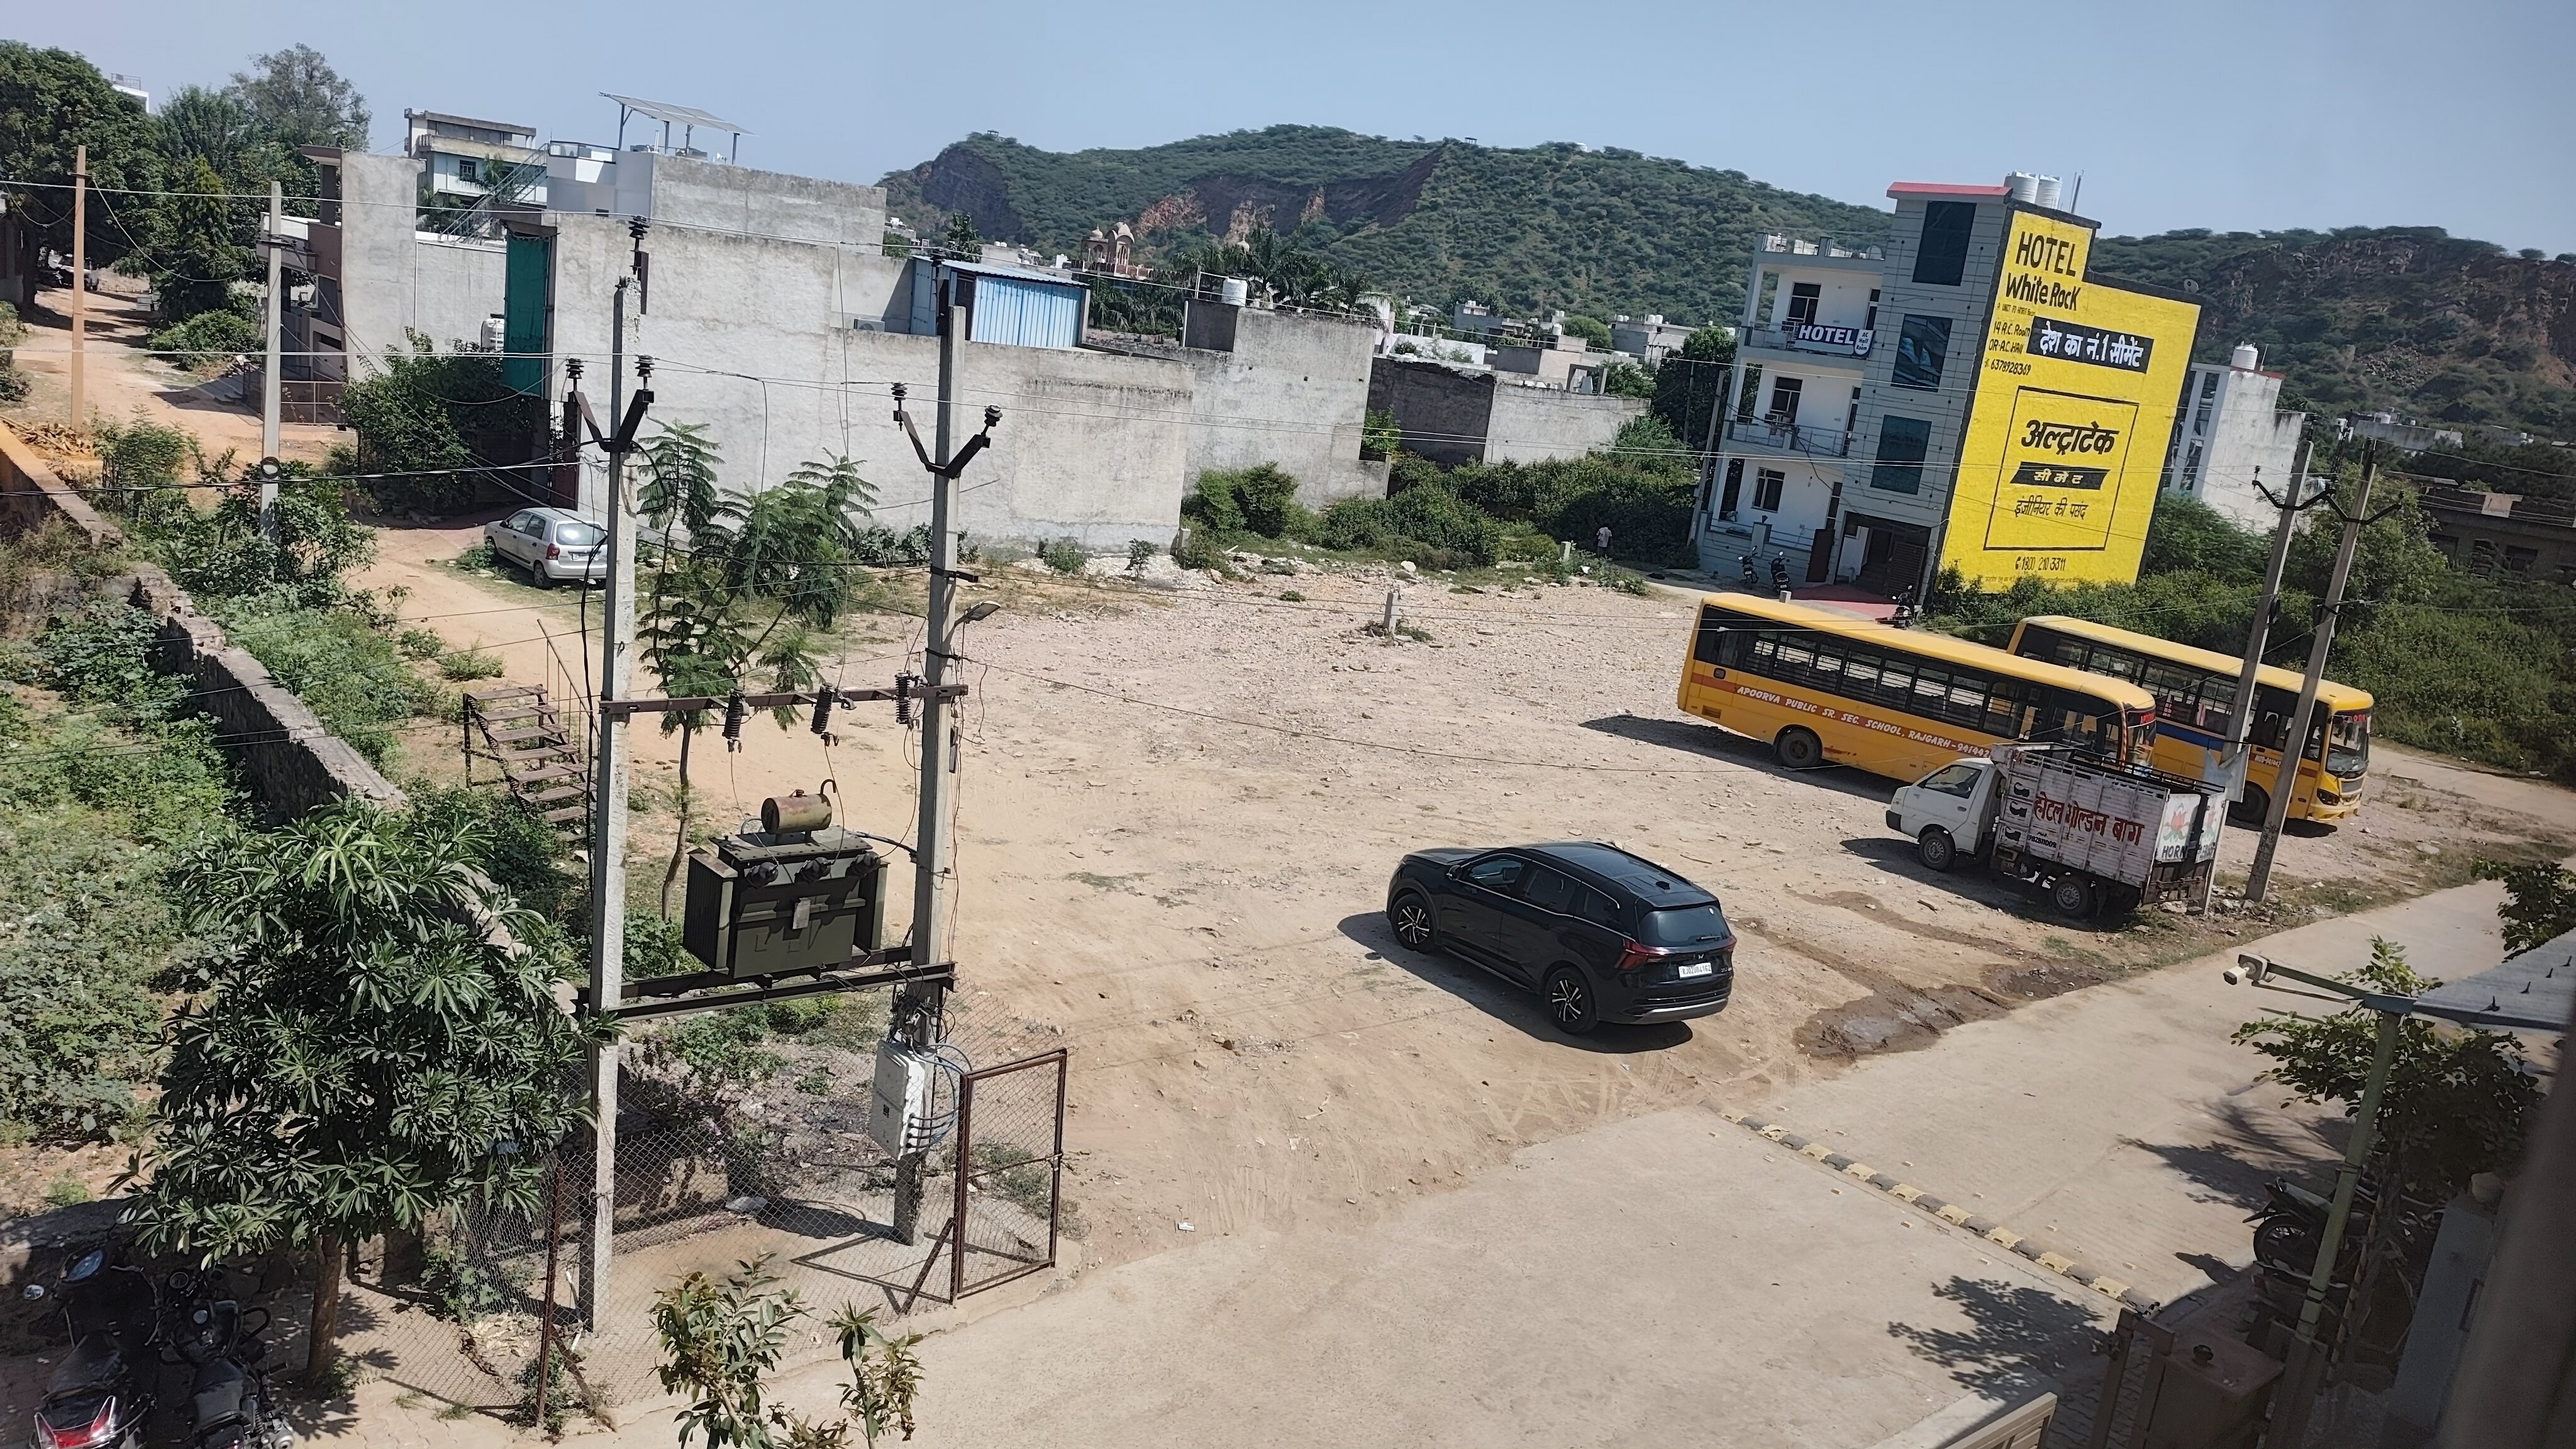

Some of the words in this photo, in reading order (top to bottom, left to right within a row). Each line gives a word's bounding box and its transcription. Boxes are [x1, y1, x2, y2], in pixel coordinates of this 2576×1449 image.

[2016, 231, 2076, 277] HOTEL
[2006, 272, 2048, 304] White
[1799, 325, 1854, 344] HOTEL
[1993, 321, 2001, 334] 14
[2040, 320, 2062, 355] देश
[2065, 334, 2083, 357] का
[2110, 335, 2144, 367] सीमेंट
[1990, 358, 2031, 375] 6378928369
[2021, 419, 2120, 455] अल्ट्राटेक
[2014, 495, 2053, 518] इंजीनियर
[2054, 497, 2068, 516] की
[2070, 501, 2089, 519] पसंद
[2021, 556, 2036, 570] 1800
[2038, 557, 2049, 571] 210
[2050, 557, 2067, 571] 3311
[1737, 686, 1780, 704] APOORVA
[1785, 698, 1817, 713] PUBLIC
[1822, 708, 1836, 718] SR.
[1841, 713, 1859, 724] SEC.
[1865, 719, 1905, 737] SCHOOL,
[2034, 791, 2065, 825] होटल
[2112, 816, 2145, 846] बाग
[2162, 845, 2189, 859] HORN
